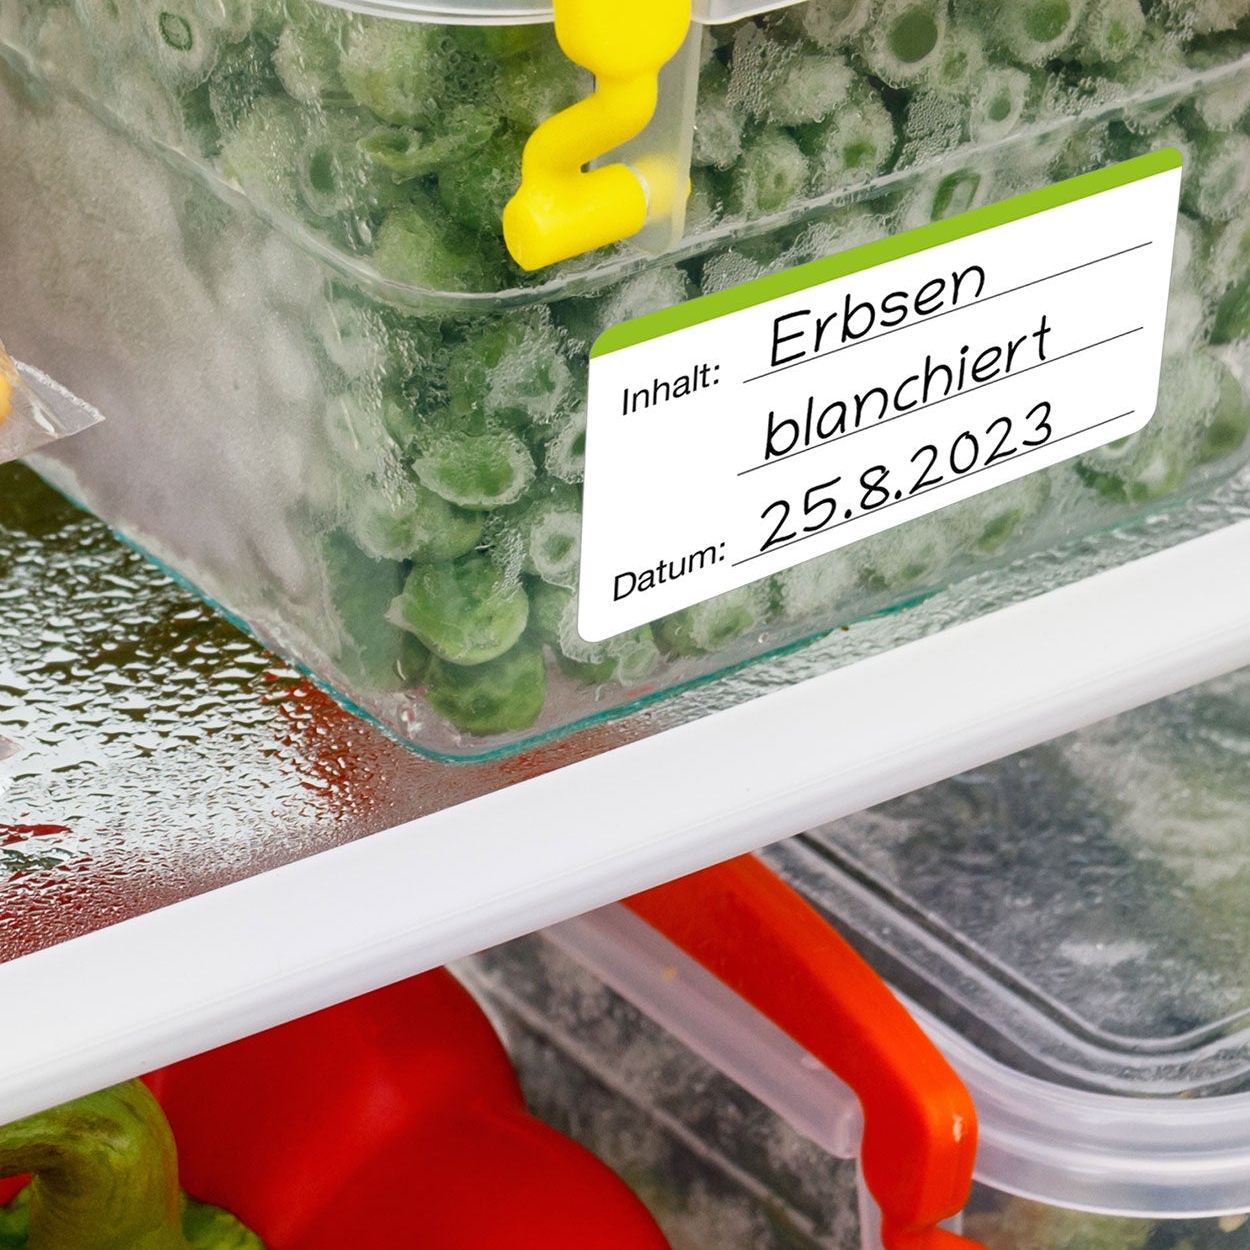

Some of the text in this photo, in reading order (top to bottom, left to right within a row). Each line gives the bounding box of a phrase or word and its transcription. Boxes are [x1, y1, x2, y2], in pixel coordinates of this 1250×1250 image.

[621, 264, 986, 416] Inhalt: Erbsen
[763, 315, 1052, 461] blanchiert
[612, 401, 1053, 602] Datum: 25.8.2023
